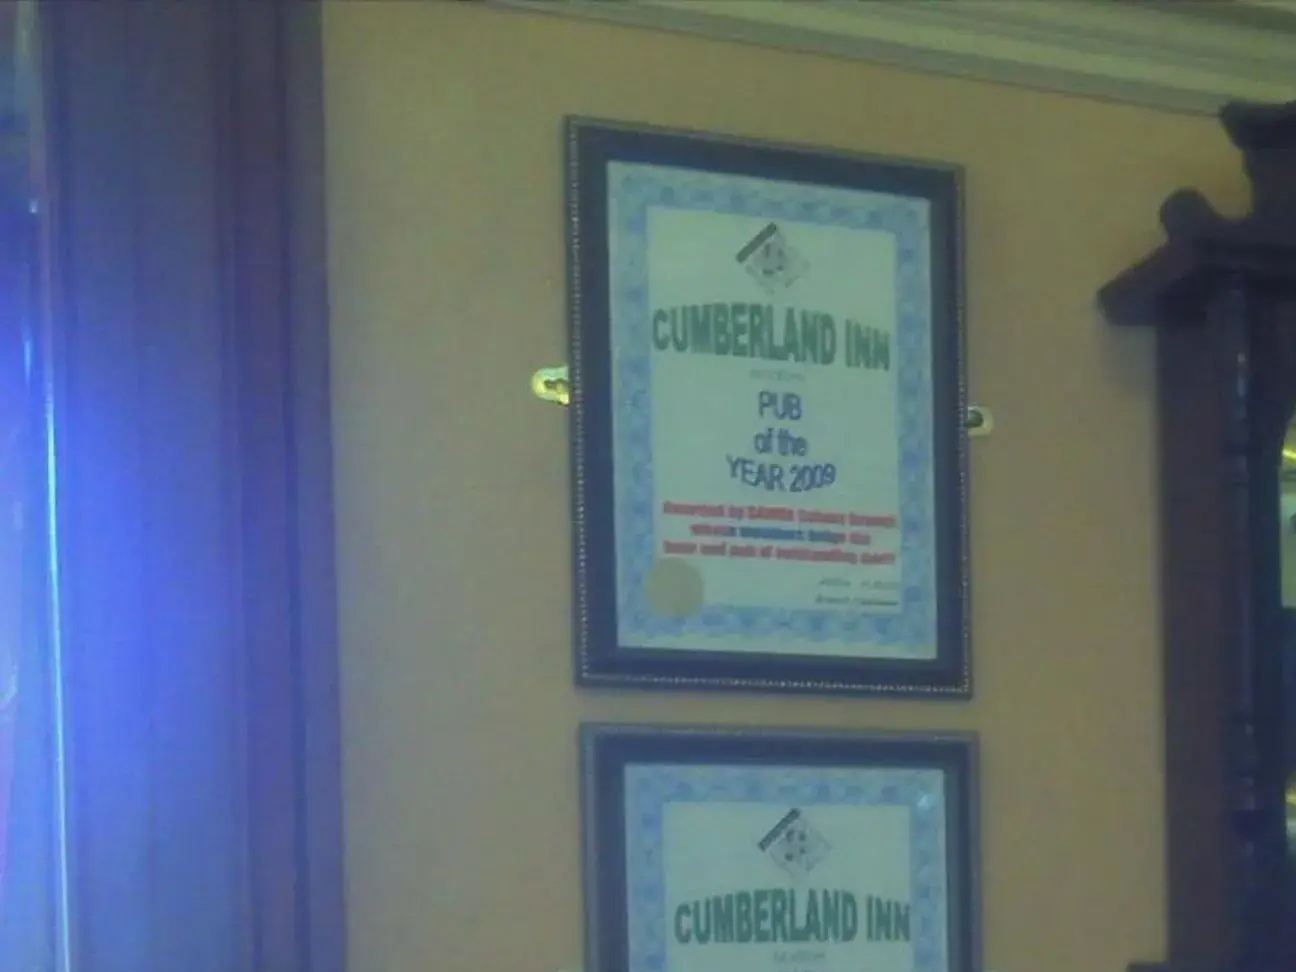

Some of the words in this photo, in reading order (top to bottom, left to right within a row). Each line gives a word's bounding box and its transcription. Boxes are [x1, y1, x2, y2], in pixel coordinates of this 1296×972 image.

[652, 302, 837, 365] CUMBERLAND
[845, 318, 890, 371] INN
[758, 390, 802, 420] PUB
[754, 427, 774, 454] of
[777, 428, 808, 456] the
[726, 453, 786, 492] YEAR
[789, 463, 836, 492] 2009
[674, 888, 858, 945] CUMBERLAND
[866, 894, 910, 942] INN
